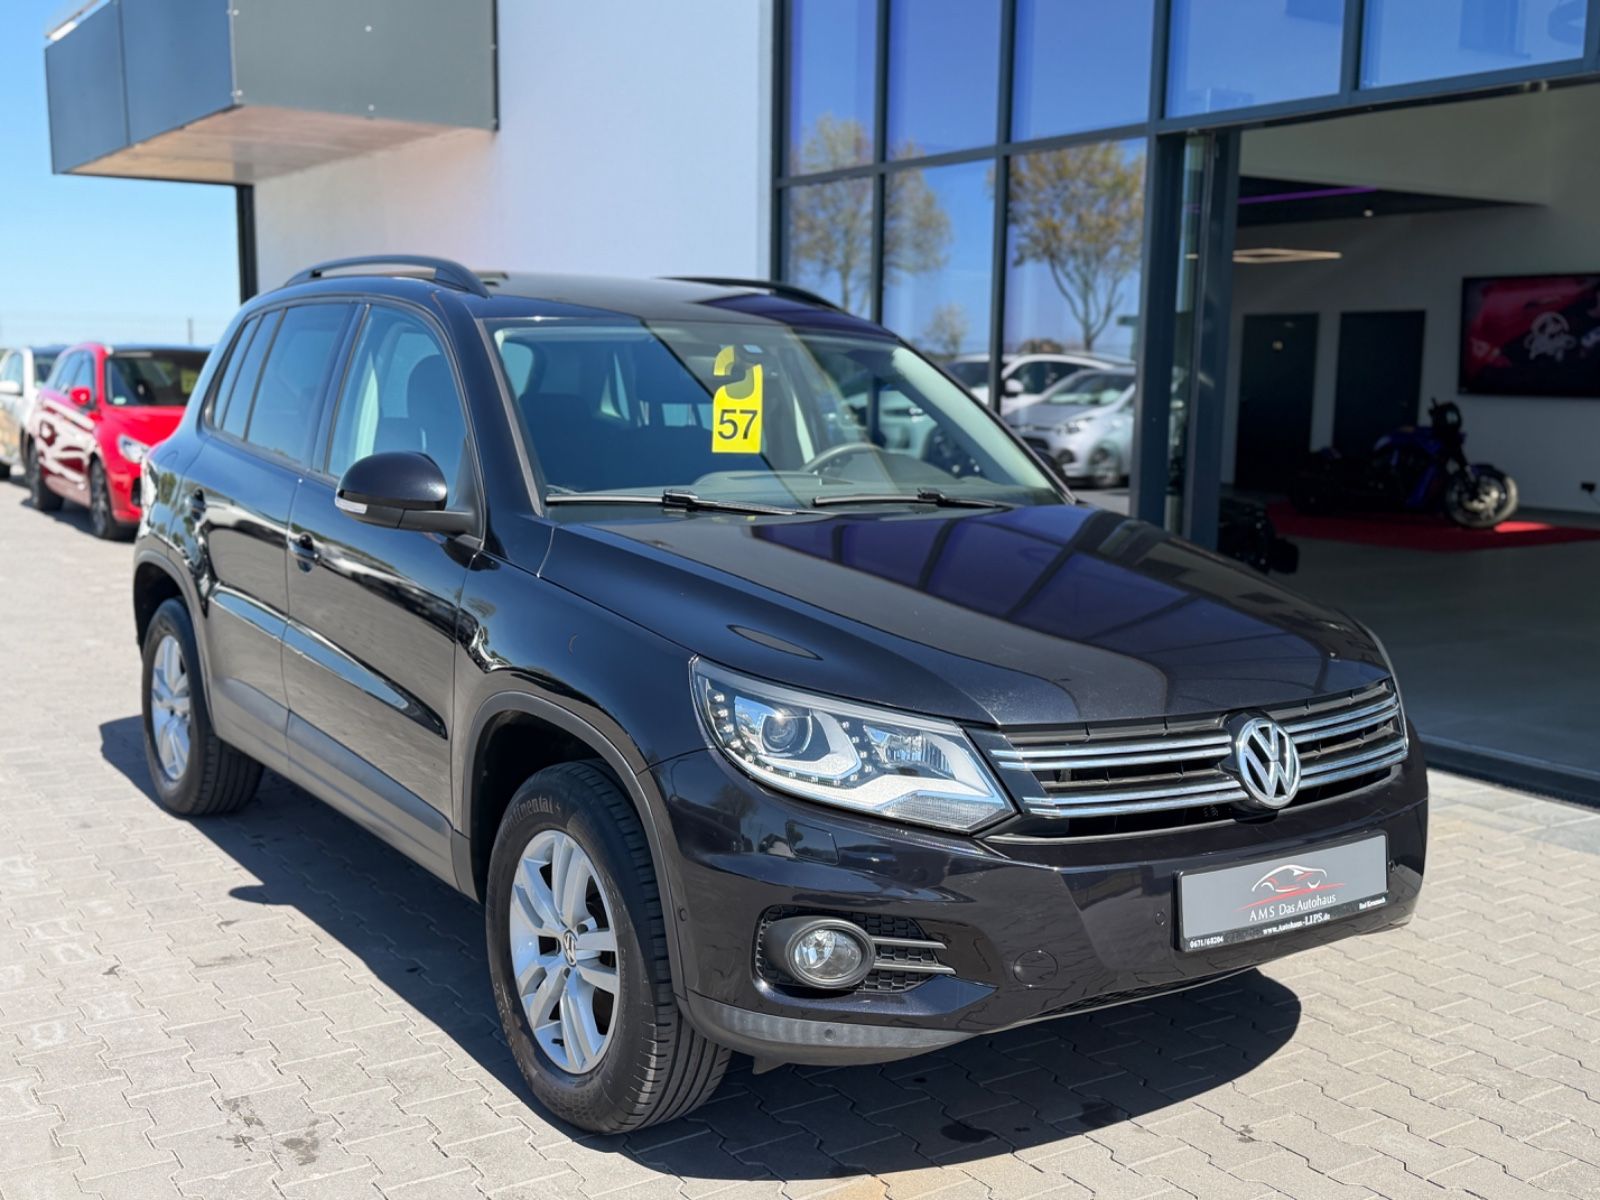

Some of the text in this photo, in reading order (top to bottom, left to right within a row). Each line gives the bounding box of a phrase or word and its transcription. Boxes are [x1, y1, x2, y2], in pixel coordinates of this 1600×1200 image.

[718, 409, 758, 440] 57
[1279, 903, 1295, 916] Das
[1296, 894, 1337, 912] Autohaus
